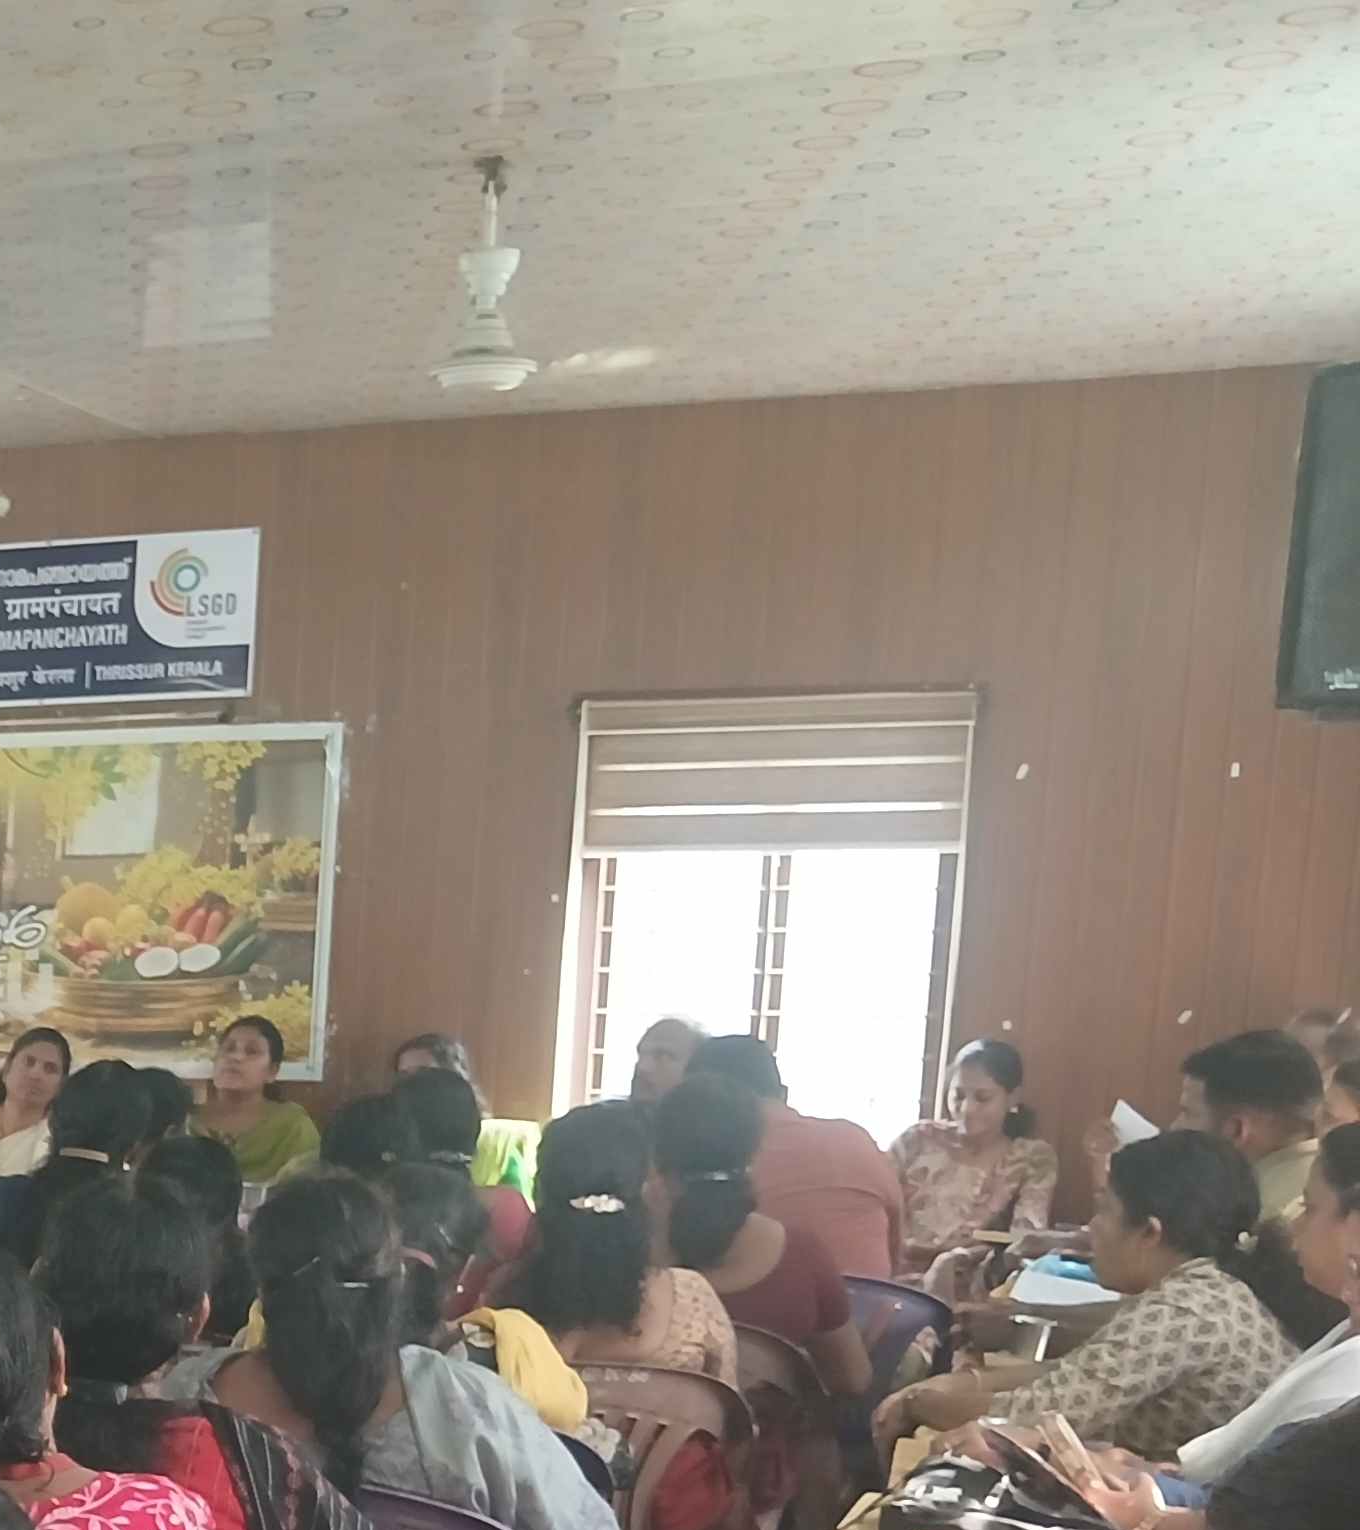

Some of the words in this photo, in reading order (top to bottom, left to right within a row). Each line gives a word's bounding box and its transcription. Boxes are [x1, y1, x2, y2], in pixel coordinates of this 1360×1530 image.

[3, 588, 122, 621] ग्रामपंचायत
[186, 592, 237, 617] LSGD
[94, 662, 165, 681] THRISSUR
[167, 659, 224, 677] KERALA
